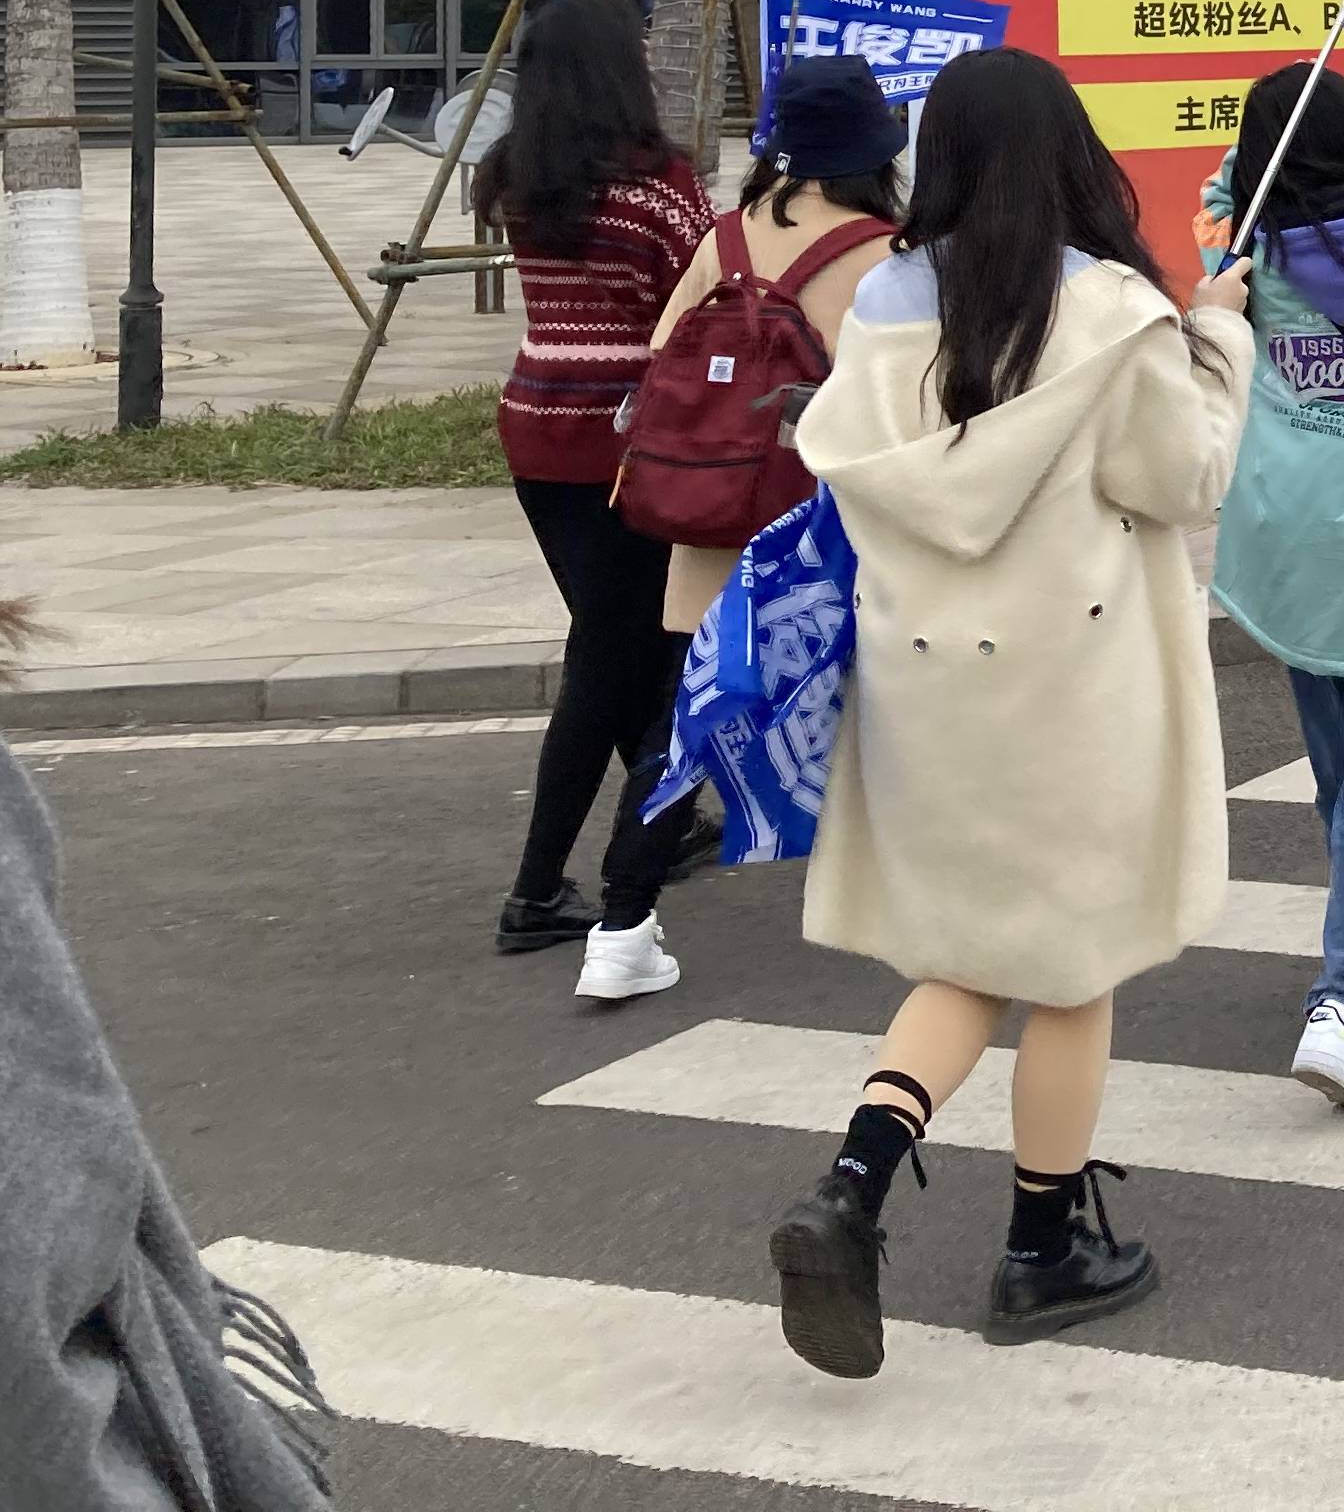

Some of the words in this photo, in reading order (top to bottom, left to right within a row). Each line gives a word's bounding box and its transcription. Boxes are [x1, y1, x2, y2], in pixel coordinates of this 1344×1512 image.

[890, 3, 937, 18] WANG
[780, 15, 984, 67] 王俊凯
[1301, 338, 1344, 357] 1956
